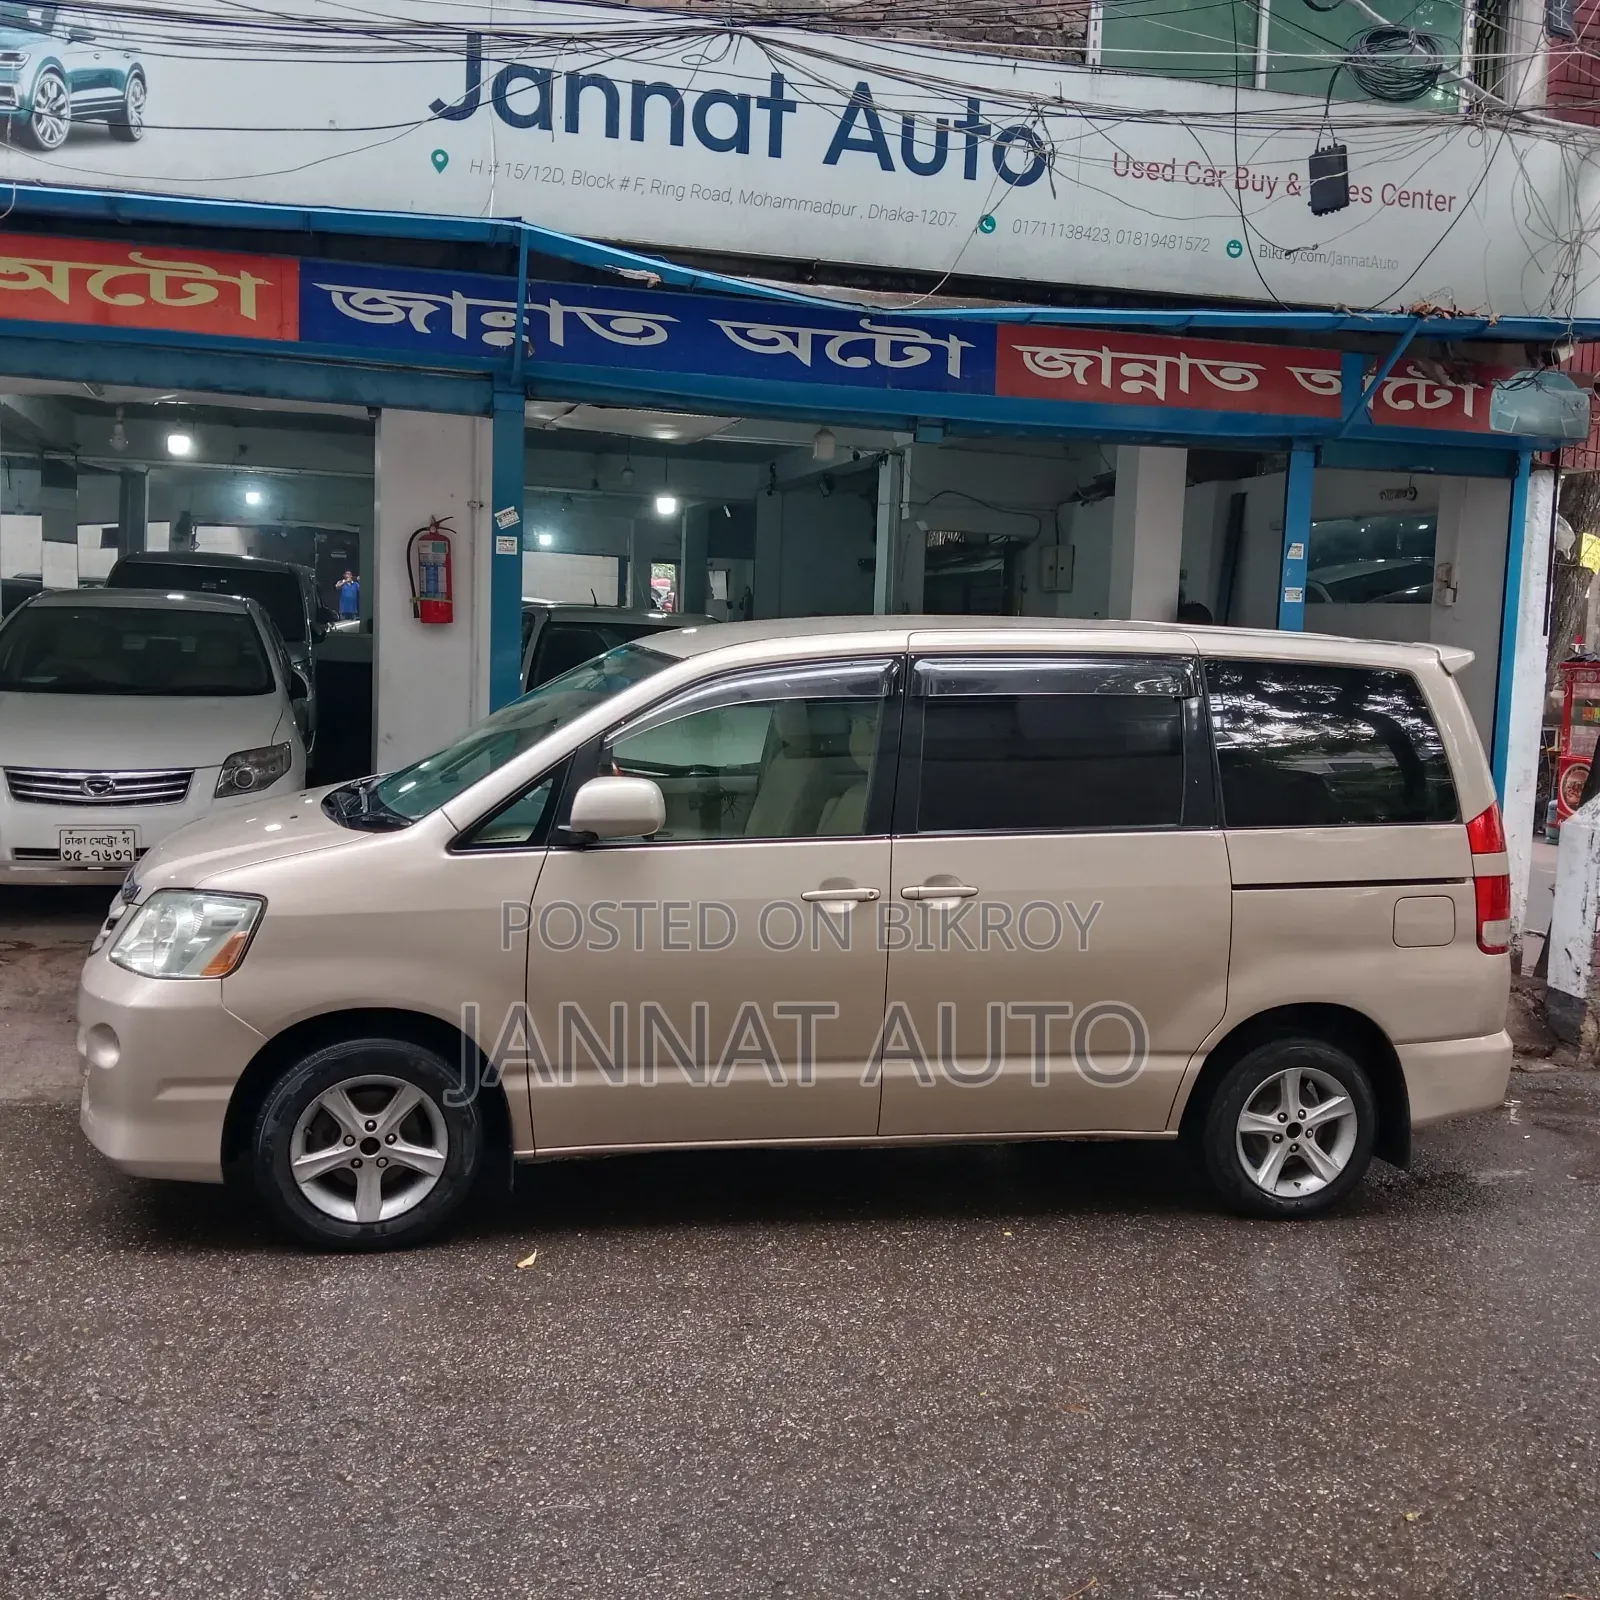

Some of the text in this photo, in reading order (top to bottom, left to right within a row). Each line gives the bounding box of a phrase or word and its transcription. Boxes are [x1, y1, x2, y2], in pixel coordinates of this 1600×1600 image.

[427, 32, 1048, 187] Jannat Auto
[469, 159, 484, 174] H
[504, 162, 565, 186] 15/12D,
[571, 169, 616, 190] Block
[619, 175, 632, 192] #
[633, 176, 646, 196] F,
[650, 178, 686, 202] Ring
[690, 184, 733, 205] Road,
[1113, 152, 1176, 183] Used
[1185, 160, 1227, 188] Car
[1234, 166, 1279, 199] Buy
[1286, 172, 1302, 197] &
[1381, 183, 1457, 212] Center
[1012, 218, 1211, 253] 01711138423, 01819481572
[0, 251, 274, 322] অটো
[311, 282, 977, 379] জান্নাত অটো
[1010, 344, 1267, 402] জান্নাত
[62, 849, 133, 861] ৩৫-৭৬৩৭
[64, 836, 87, 845] ঢাকা
